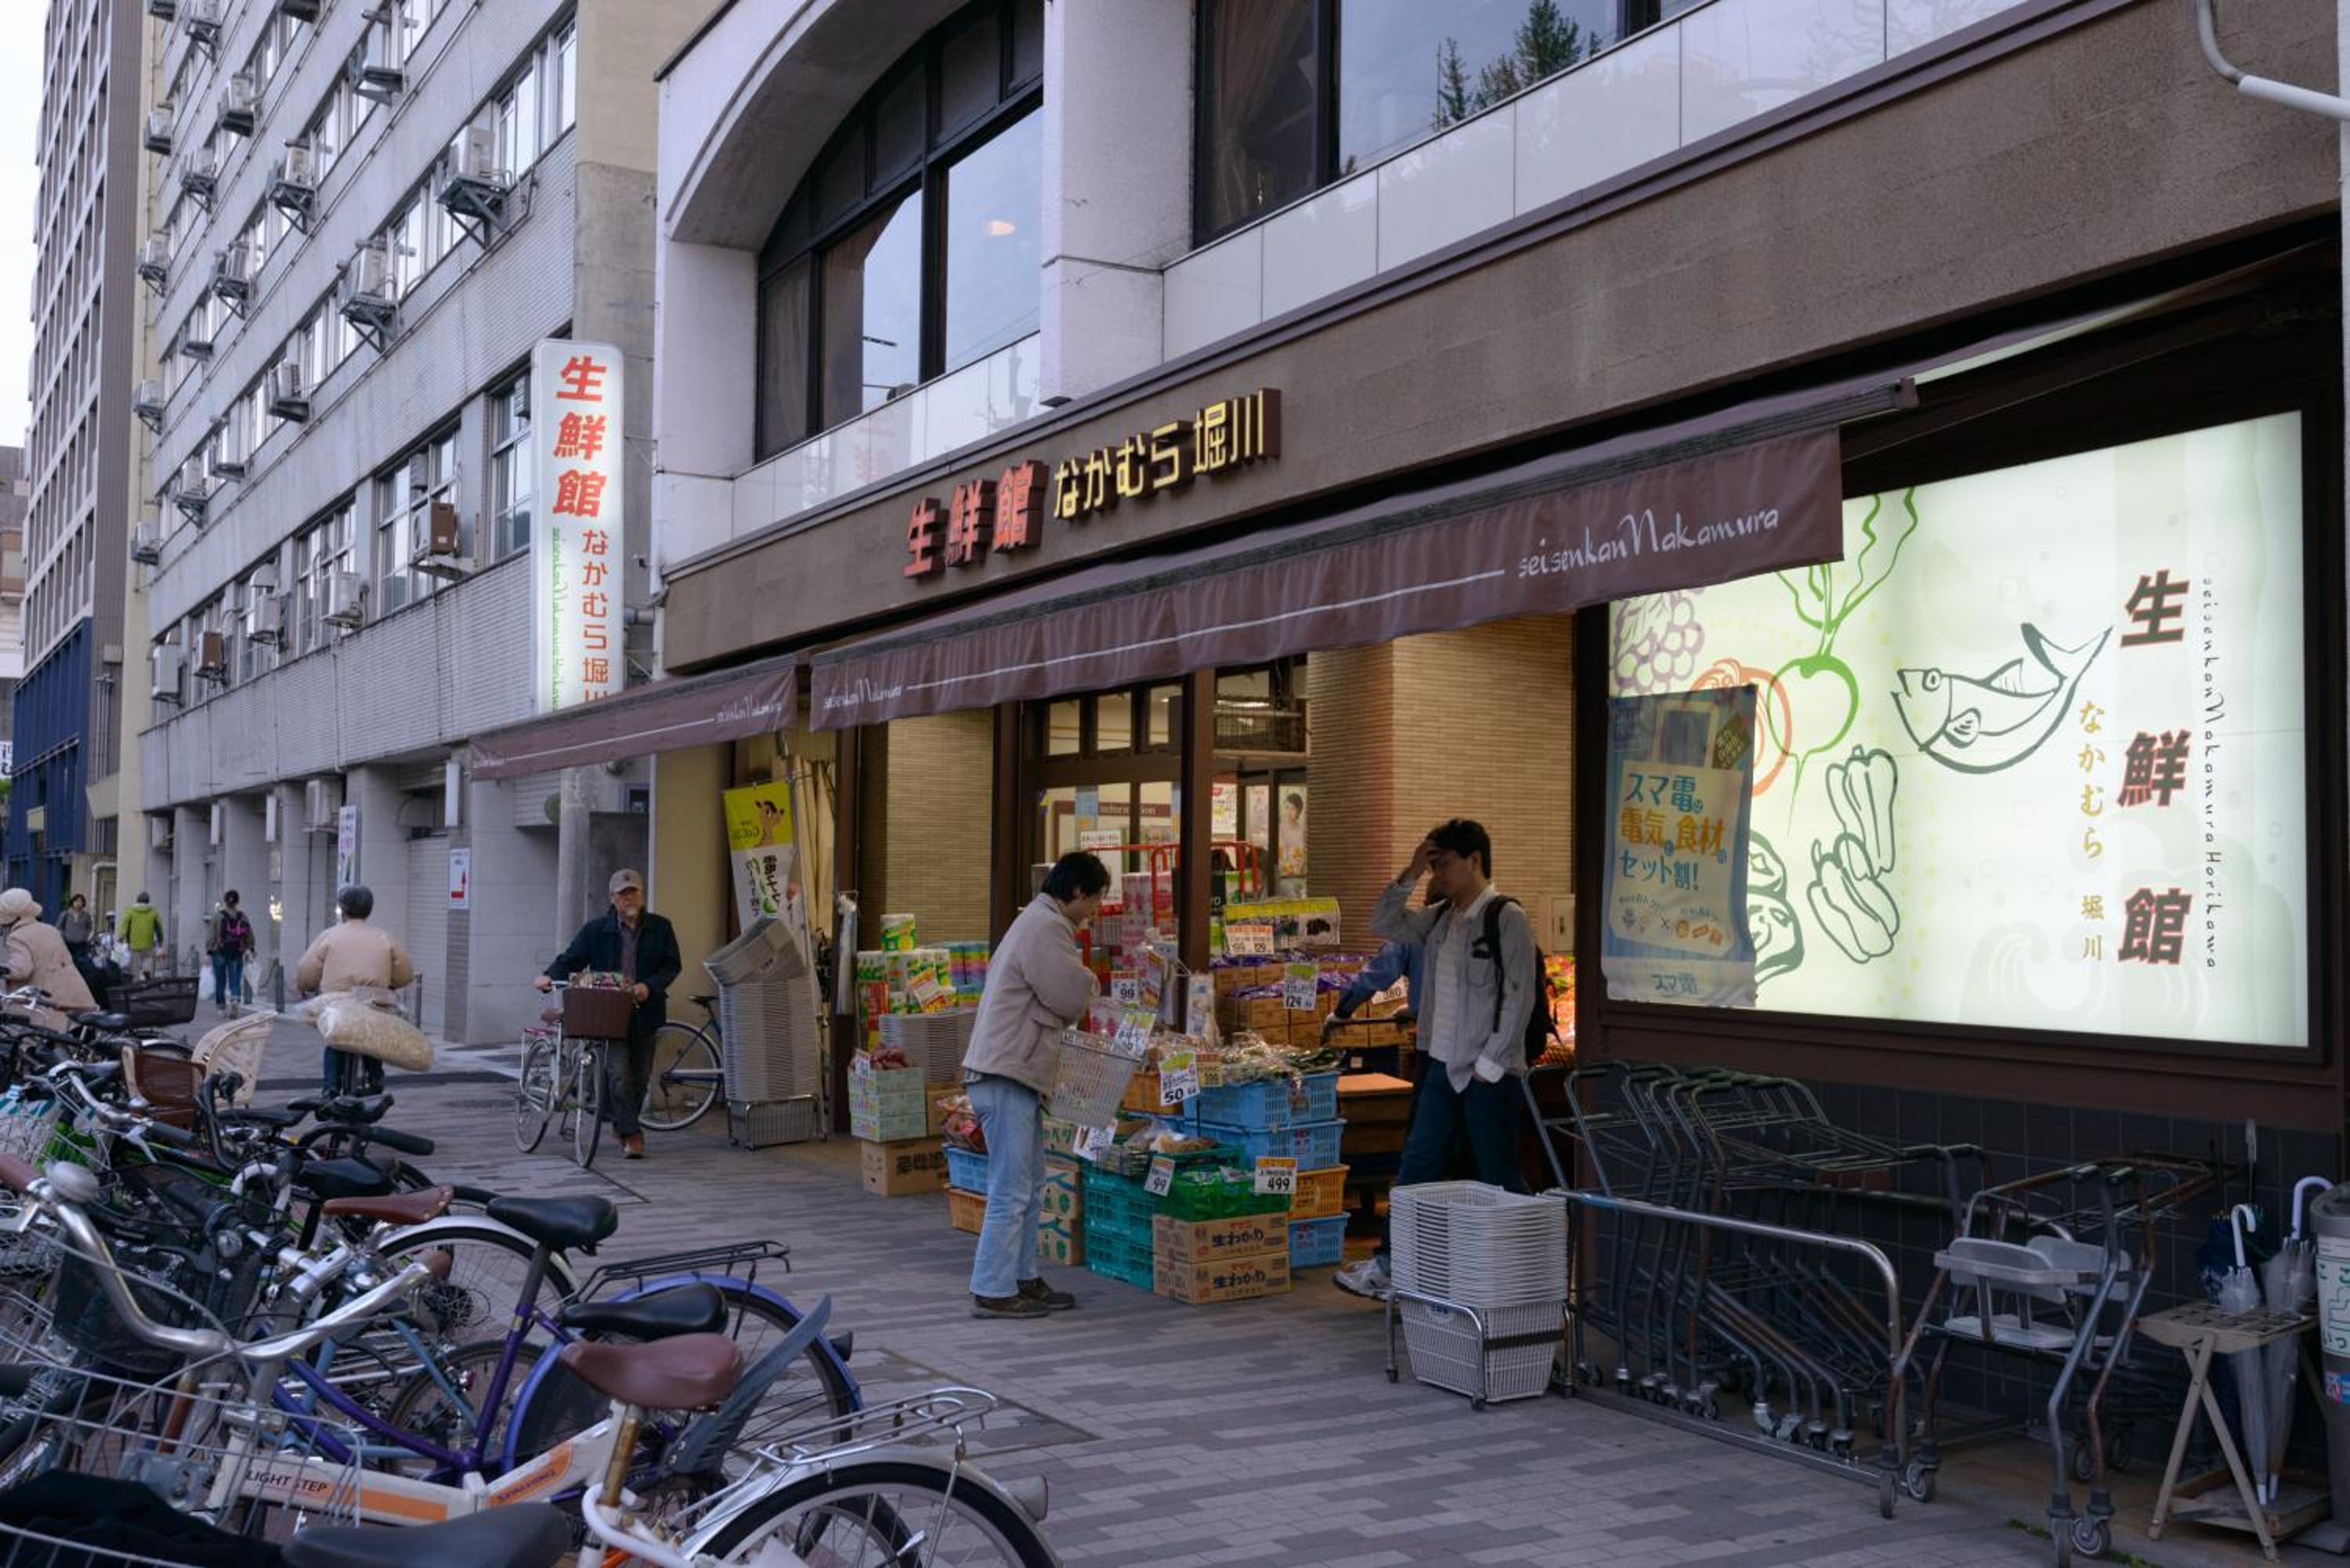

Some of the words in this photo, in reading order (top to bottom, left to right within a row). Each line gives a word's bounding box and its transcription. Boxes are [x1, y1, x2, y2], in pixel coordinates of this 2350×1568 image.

[551, 356, 607, 517] 生鮮館
[903, 459, 1036, 578] 生鮮館
[1054, 389, 1266, 519] なかむら堀川
[1518, 509, 1780, 578] seisenkanNakamura
[2078, 700, 2106, 859] なかむら
[2117, 569, 2192, 965] 生鮮館
[2081, 894, 2106, 961] 堀川
[1164, 1088, 1184, 1104] 50
[1153, 1177, 1167, 1191] 99
[1267, 1177, 1290, 1190] 499
[246, 1471, 292, 1486] LIGHT
[294, 1478, 327, 1492] TEP
